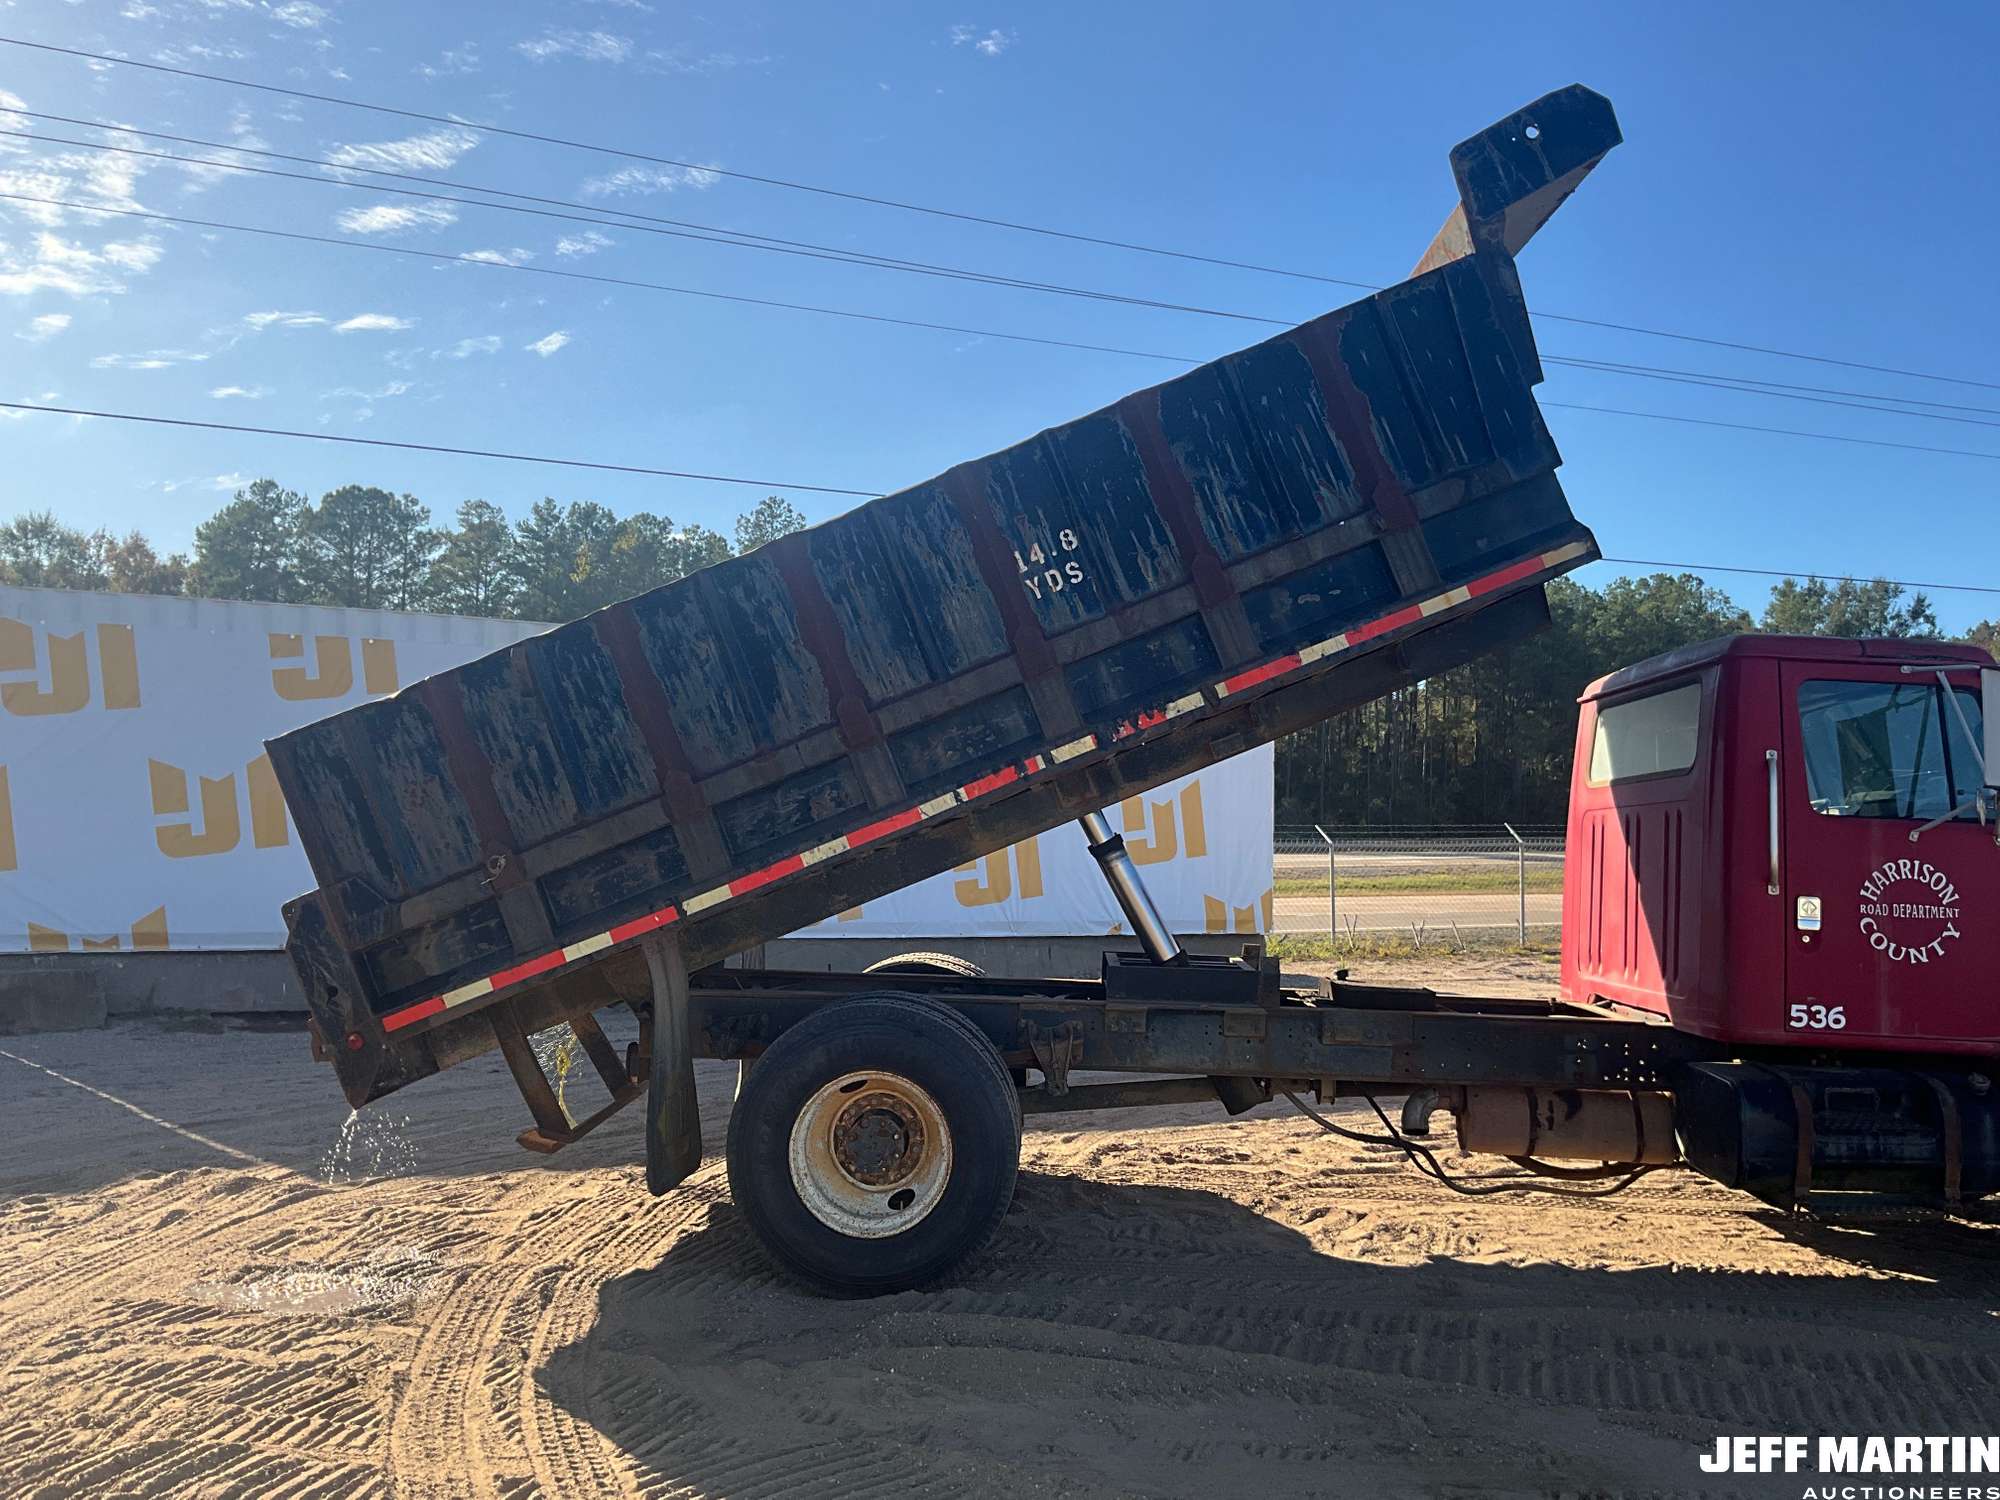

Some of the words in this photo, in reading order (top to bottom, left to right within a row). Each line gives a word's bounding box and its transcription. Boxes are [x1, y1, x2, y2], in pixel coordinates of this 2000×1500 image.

[1014, 528, 1079, 573] 14.8
[1025, 561, 1084, 600] YDS
[1860, 859, 1960, 905] HARRISON
[1860, 903, 1889, 916] ROAD
[1893, 903, 1960, 918] DEPARTMENT
[1860, 917, 1960, 964] COUNTY
[1789, 1004, 1847, 1029] 536
